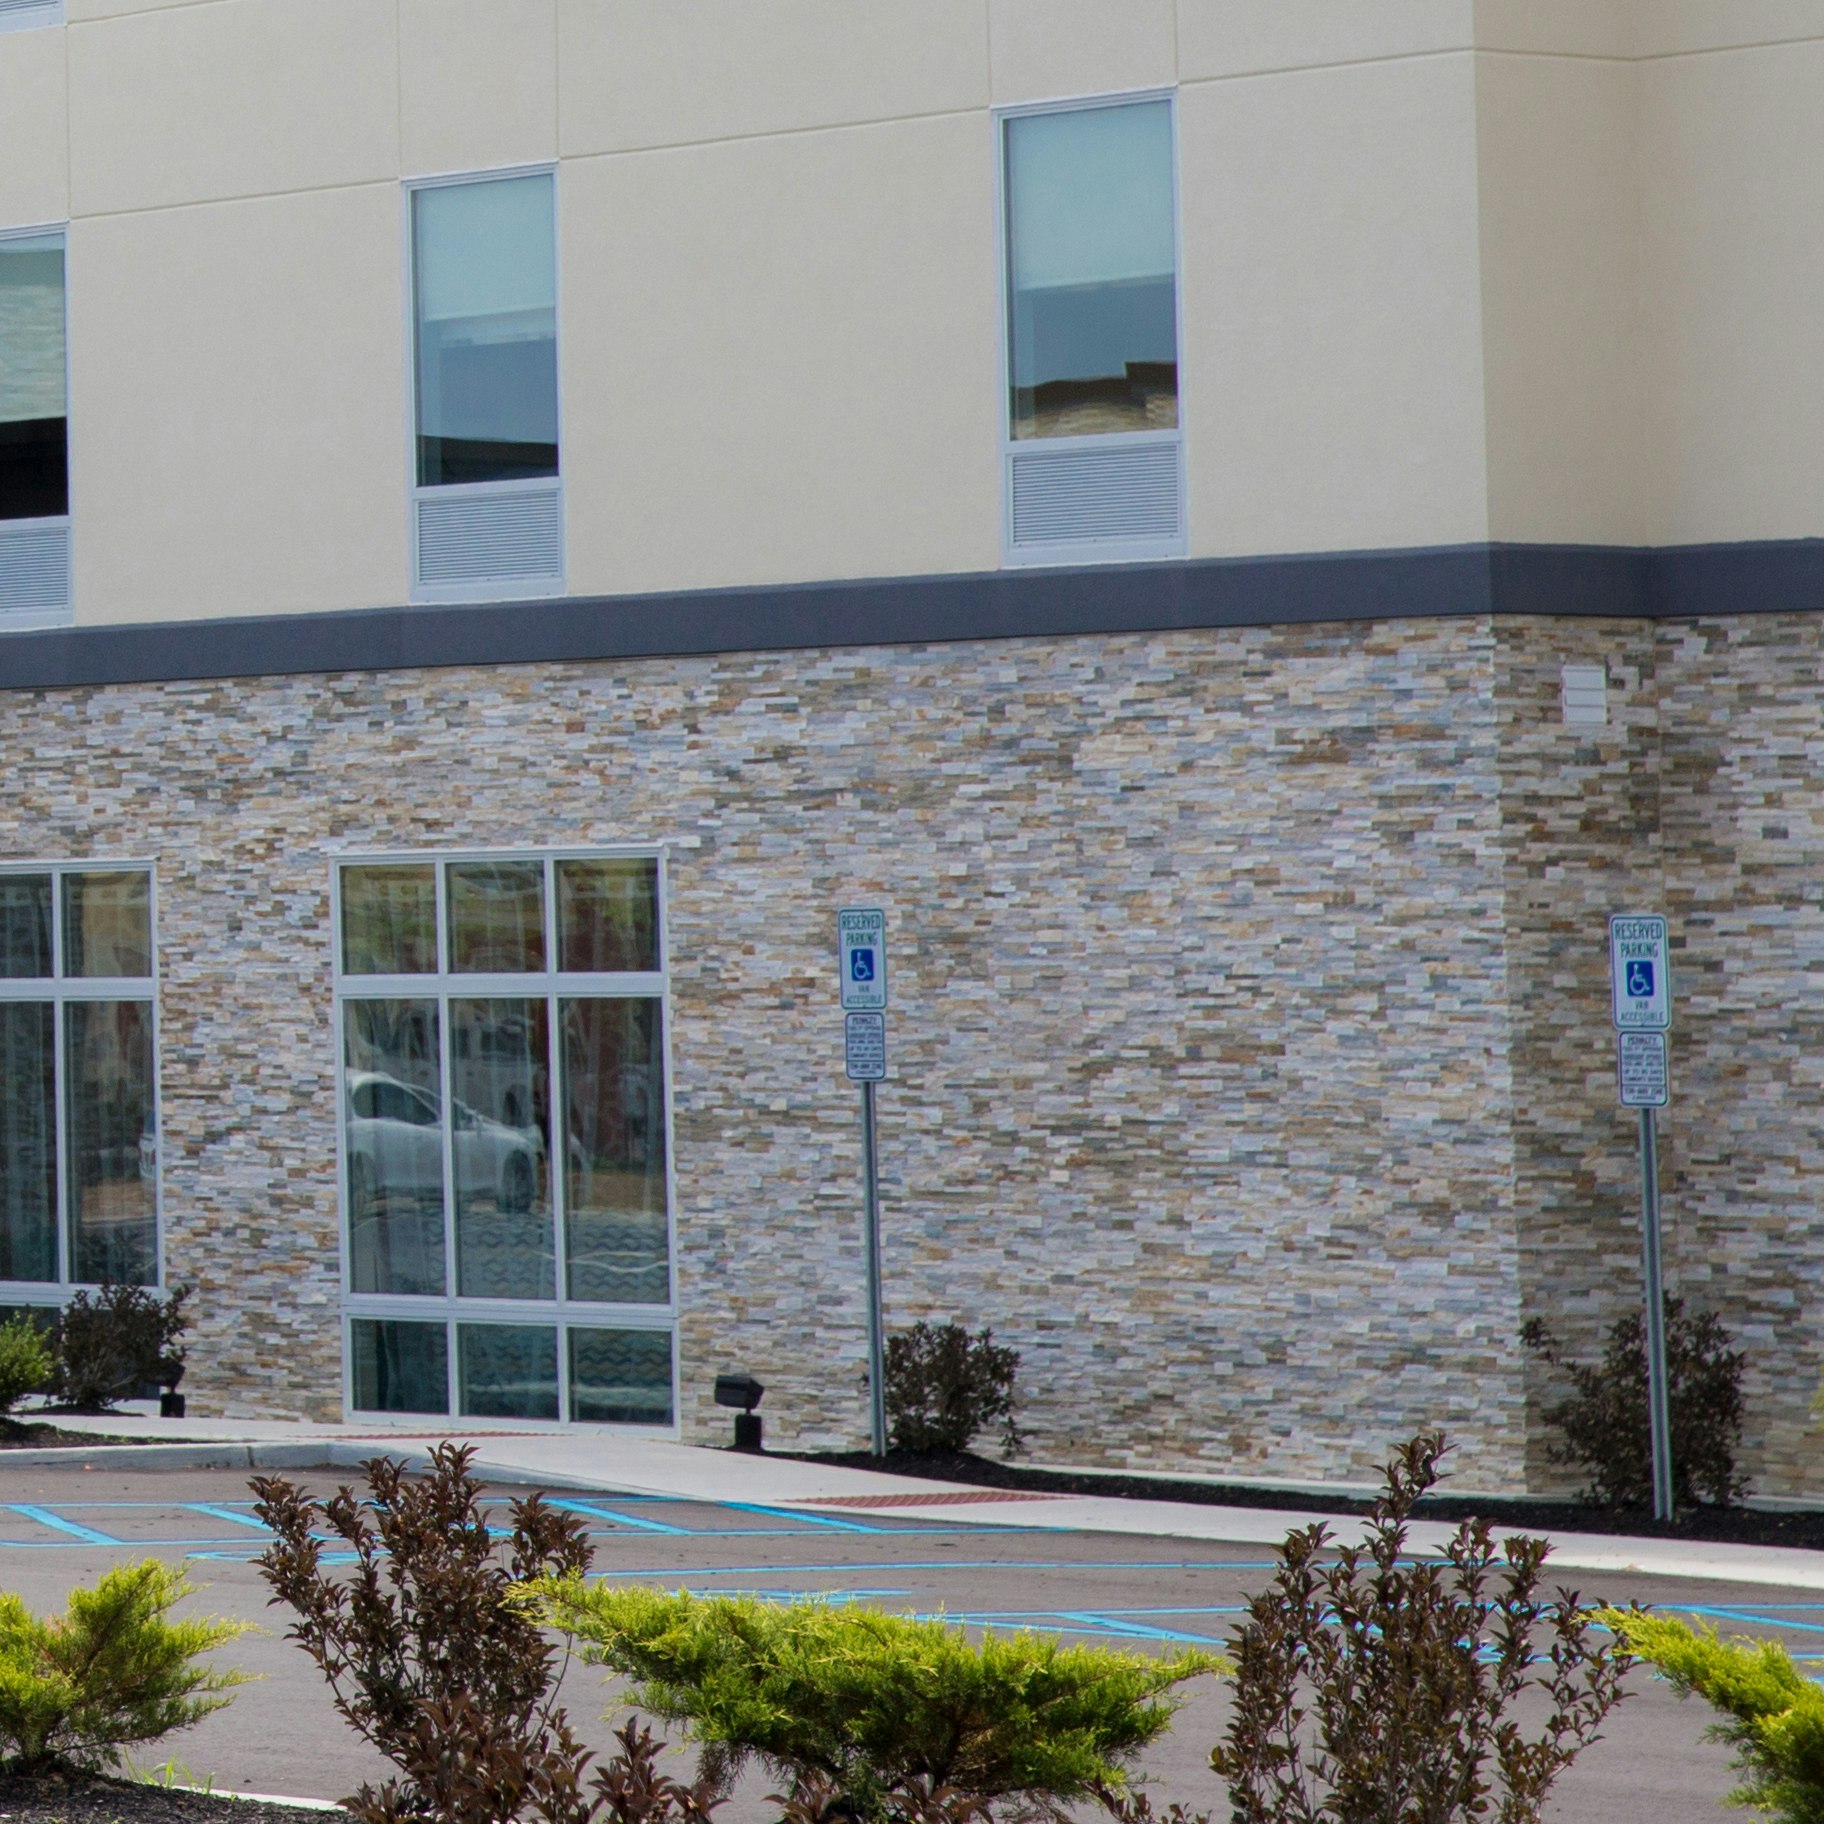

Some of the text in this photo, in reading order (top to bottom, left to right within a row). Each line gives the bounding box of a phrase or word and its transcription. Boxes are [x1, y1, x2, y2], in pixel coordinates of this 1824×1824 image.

[841, 914, 881, 930] RESERVED
[846, 931, 878, 947] PARKING
[1614, 922, 1663, 940] RESERVED
[1620, 942, 1659, 958] PARKING
[1620, 1011, 1665, 1022] ACCESSIBLE
